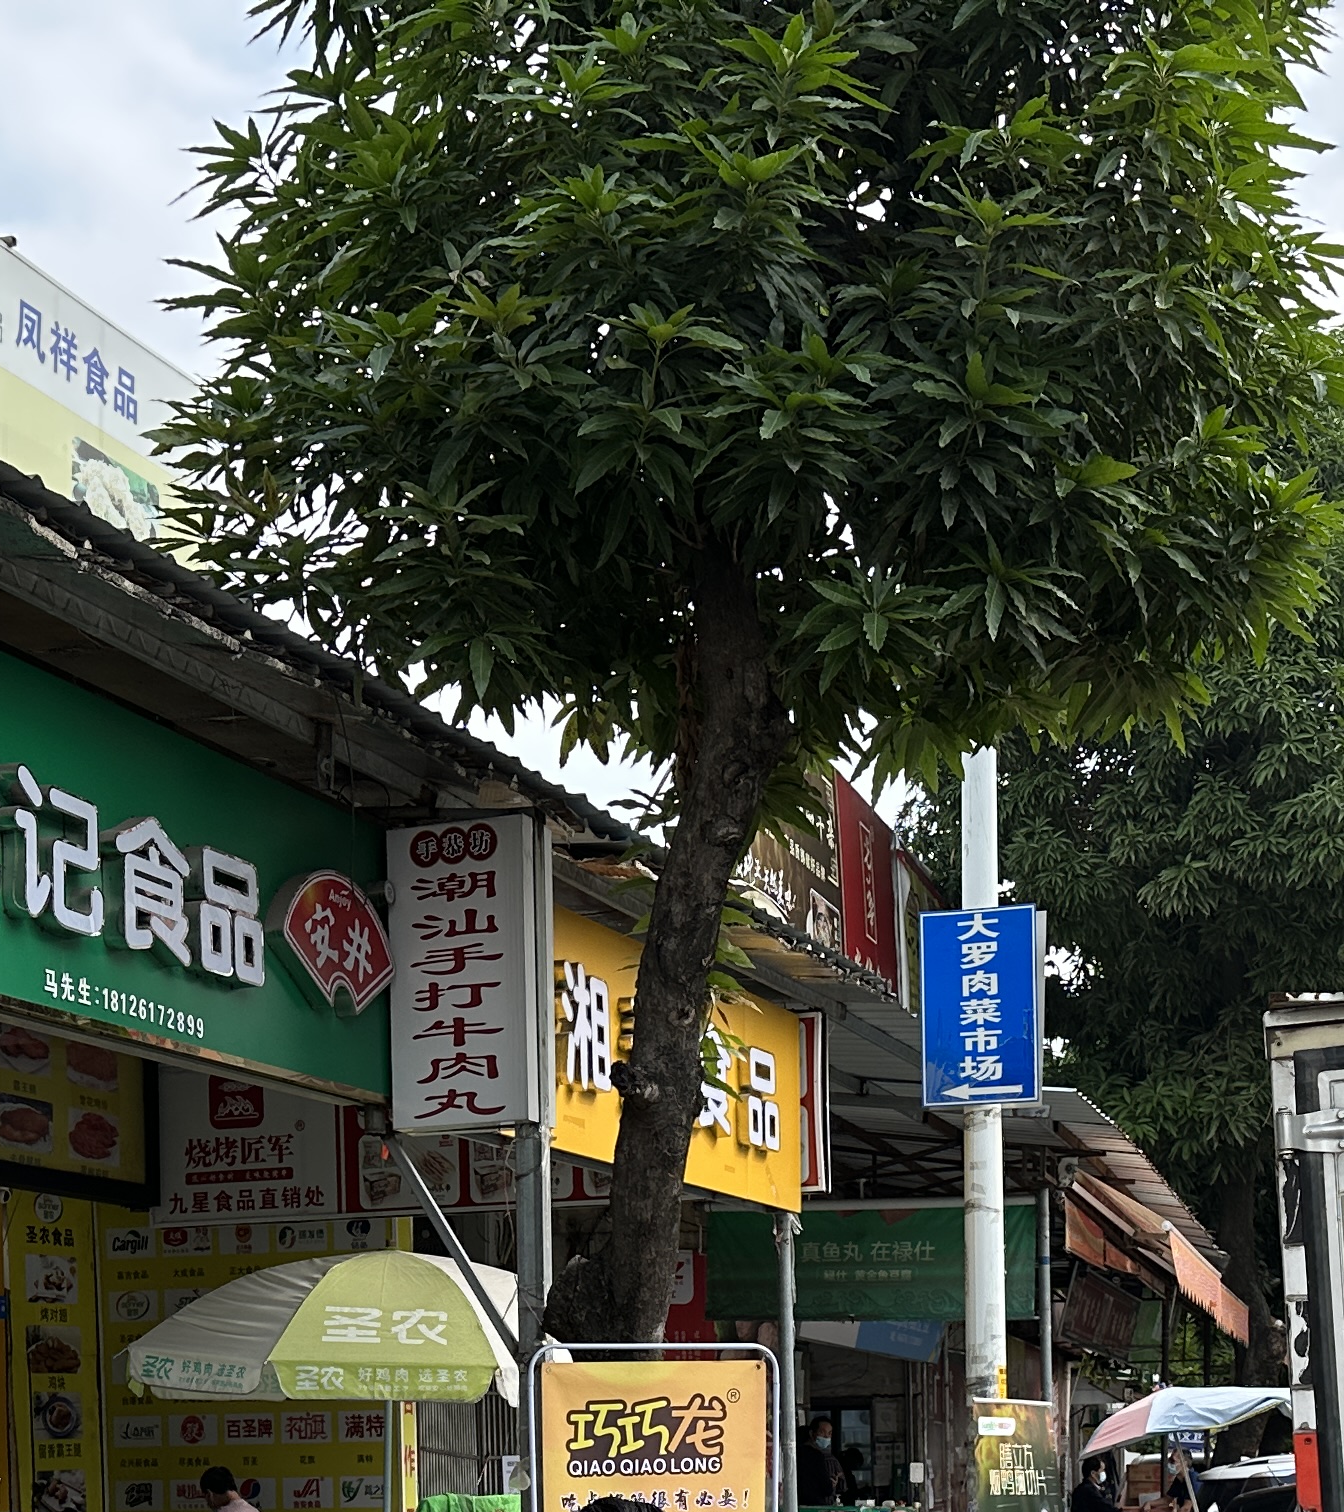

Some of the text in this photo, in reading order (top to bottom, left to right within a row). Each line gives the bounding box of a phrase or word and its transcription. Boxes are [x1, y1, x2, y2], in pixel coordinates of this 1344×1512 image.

[15, 299, 138, 425] 凤祥食品
[414, 828, 492, 862] 手恭坊
[327, 886, 353, 913] Anjoy
[303, 902, 374, 985] 安井
[42, 967, 205, 1040] 马先生:18126172899
[410, 868, 506, 1120] 潮汕手打牛肉丸
[956, 914, 1004, 1083] 大罗肉菜市场
[563, 960, 781, 1152] 湘食品
[184, 1133, 295, 1169] 烧烤匠军
[169, 1185, 325, 1215] 九星食品直销处
[25, 1225, 75, 1248] 圣农食品
[112, 1235, 149, 1255] Cargill
[800, 1241, 864, 1263] 真鱼丸
[321, 1305, 448, 1347] 圣农
[140, 1354, 175, 1381] 圣农
[295, 1365, 345, 1391] 圣农
[357, 1366, 410, 1384] 好鸡肉
[418, 1366, 468, 1384] 选圣农
[226, 1418, 273, 1439] 百圣牌
[285, 1411, 328, 1440] 花旗
[345, 1414, 385, 1438] 满特
[567, 1392, 726, 1457] 巧巧龙
[568, 1456, 722, 1477] QIAO QIAO LONG
